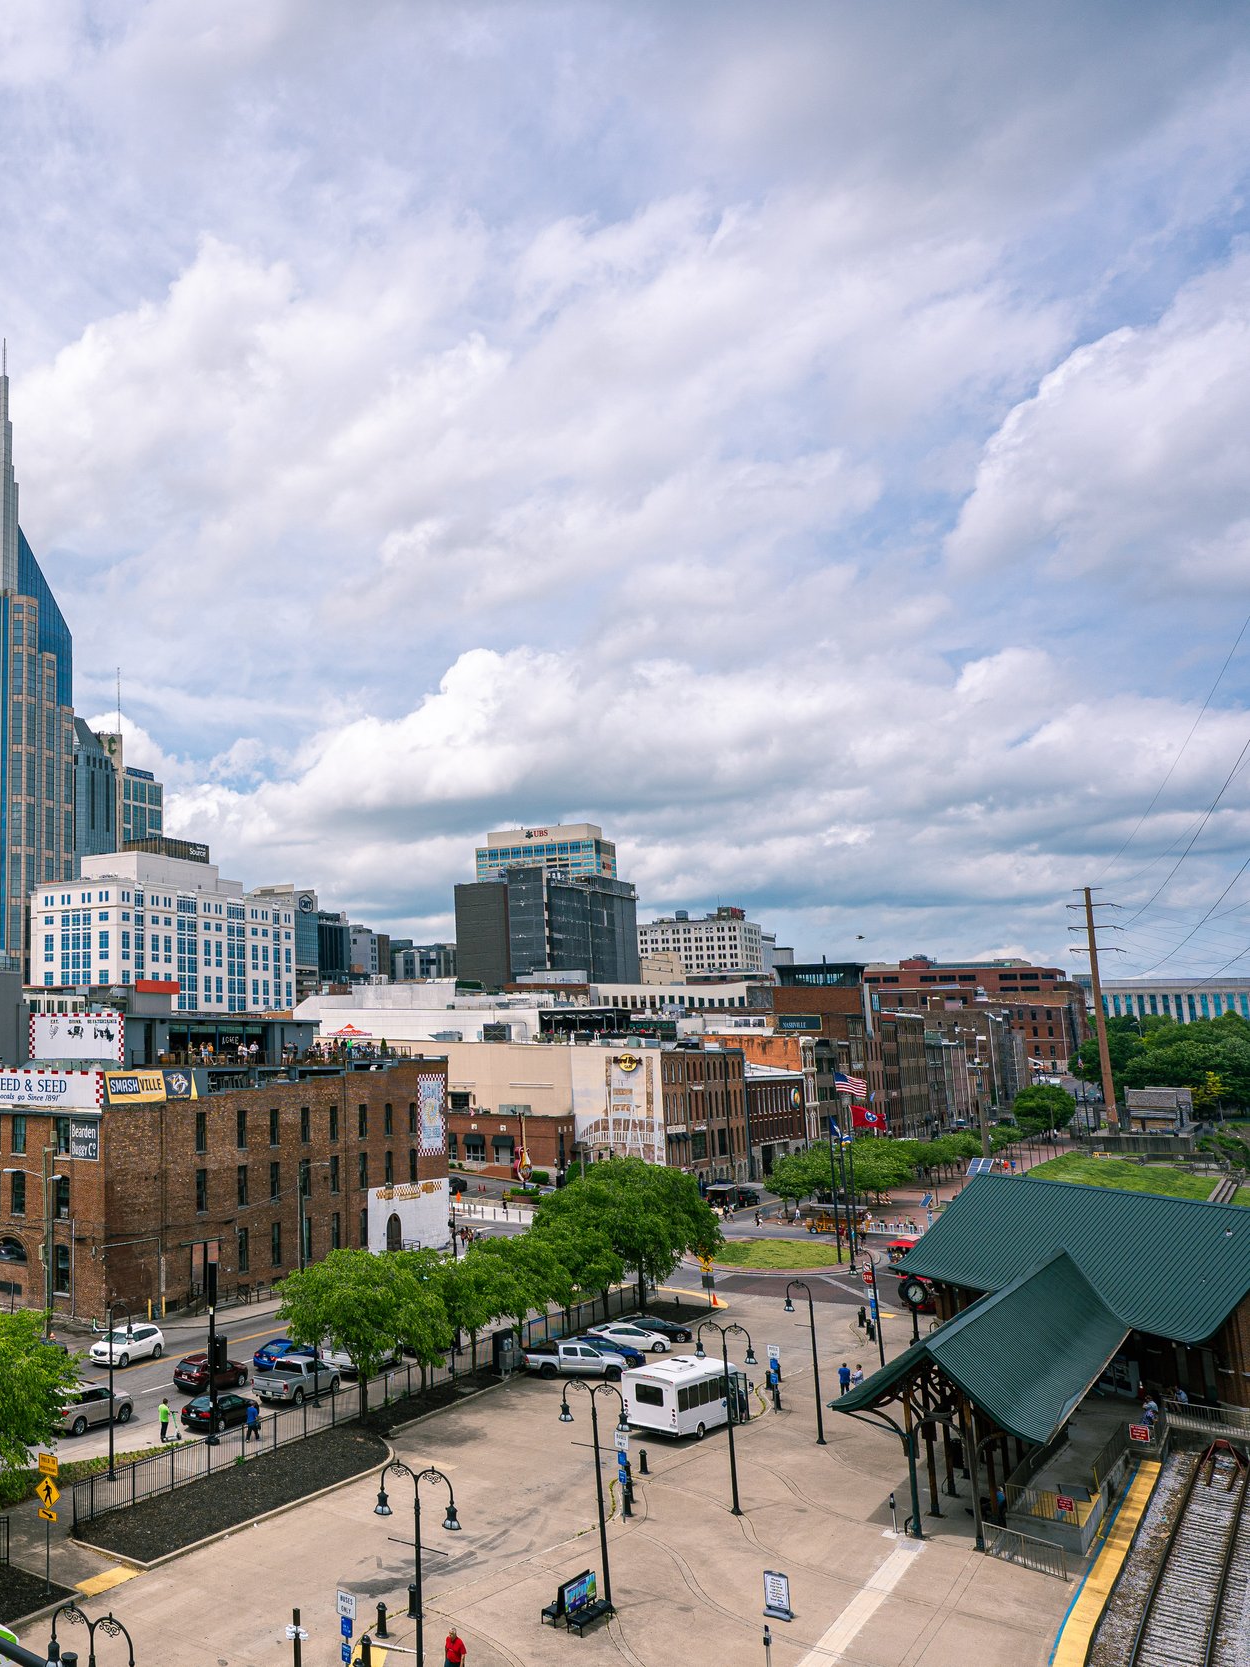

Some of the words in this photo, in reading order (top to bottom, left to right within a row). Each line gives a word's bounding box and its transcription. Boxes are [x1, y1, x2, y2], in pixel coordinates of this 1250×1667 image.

[533, 830, 548, 838] UBS
[24, 1078, 33, 1092] &
[37, 1079, 67, 1094] SEED
[28, 1094, 44, 1102] Since
[71, 1124, 97, 1139] Bearden
[340, 1594, 353, 1606] BUSES
